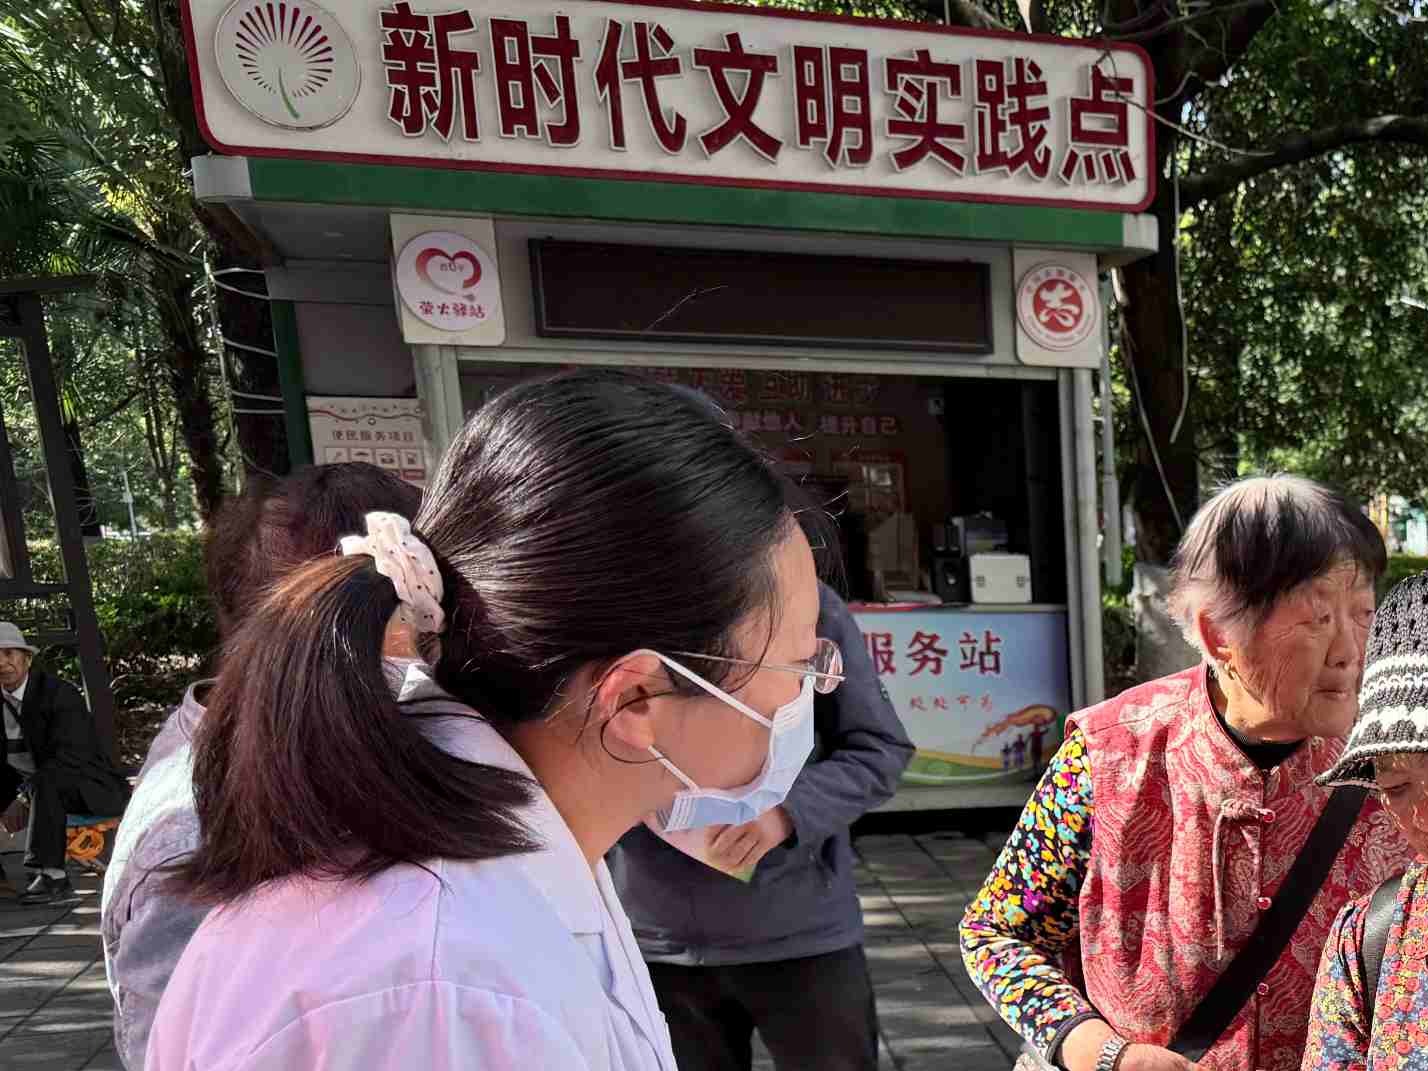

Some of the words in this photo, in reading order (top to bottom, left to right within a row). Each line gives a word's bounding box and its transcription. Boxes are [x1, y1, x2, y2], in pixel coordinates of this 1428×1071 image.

[382, 2, 1137, 187] 新时代文明实践点
